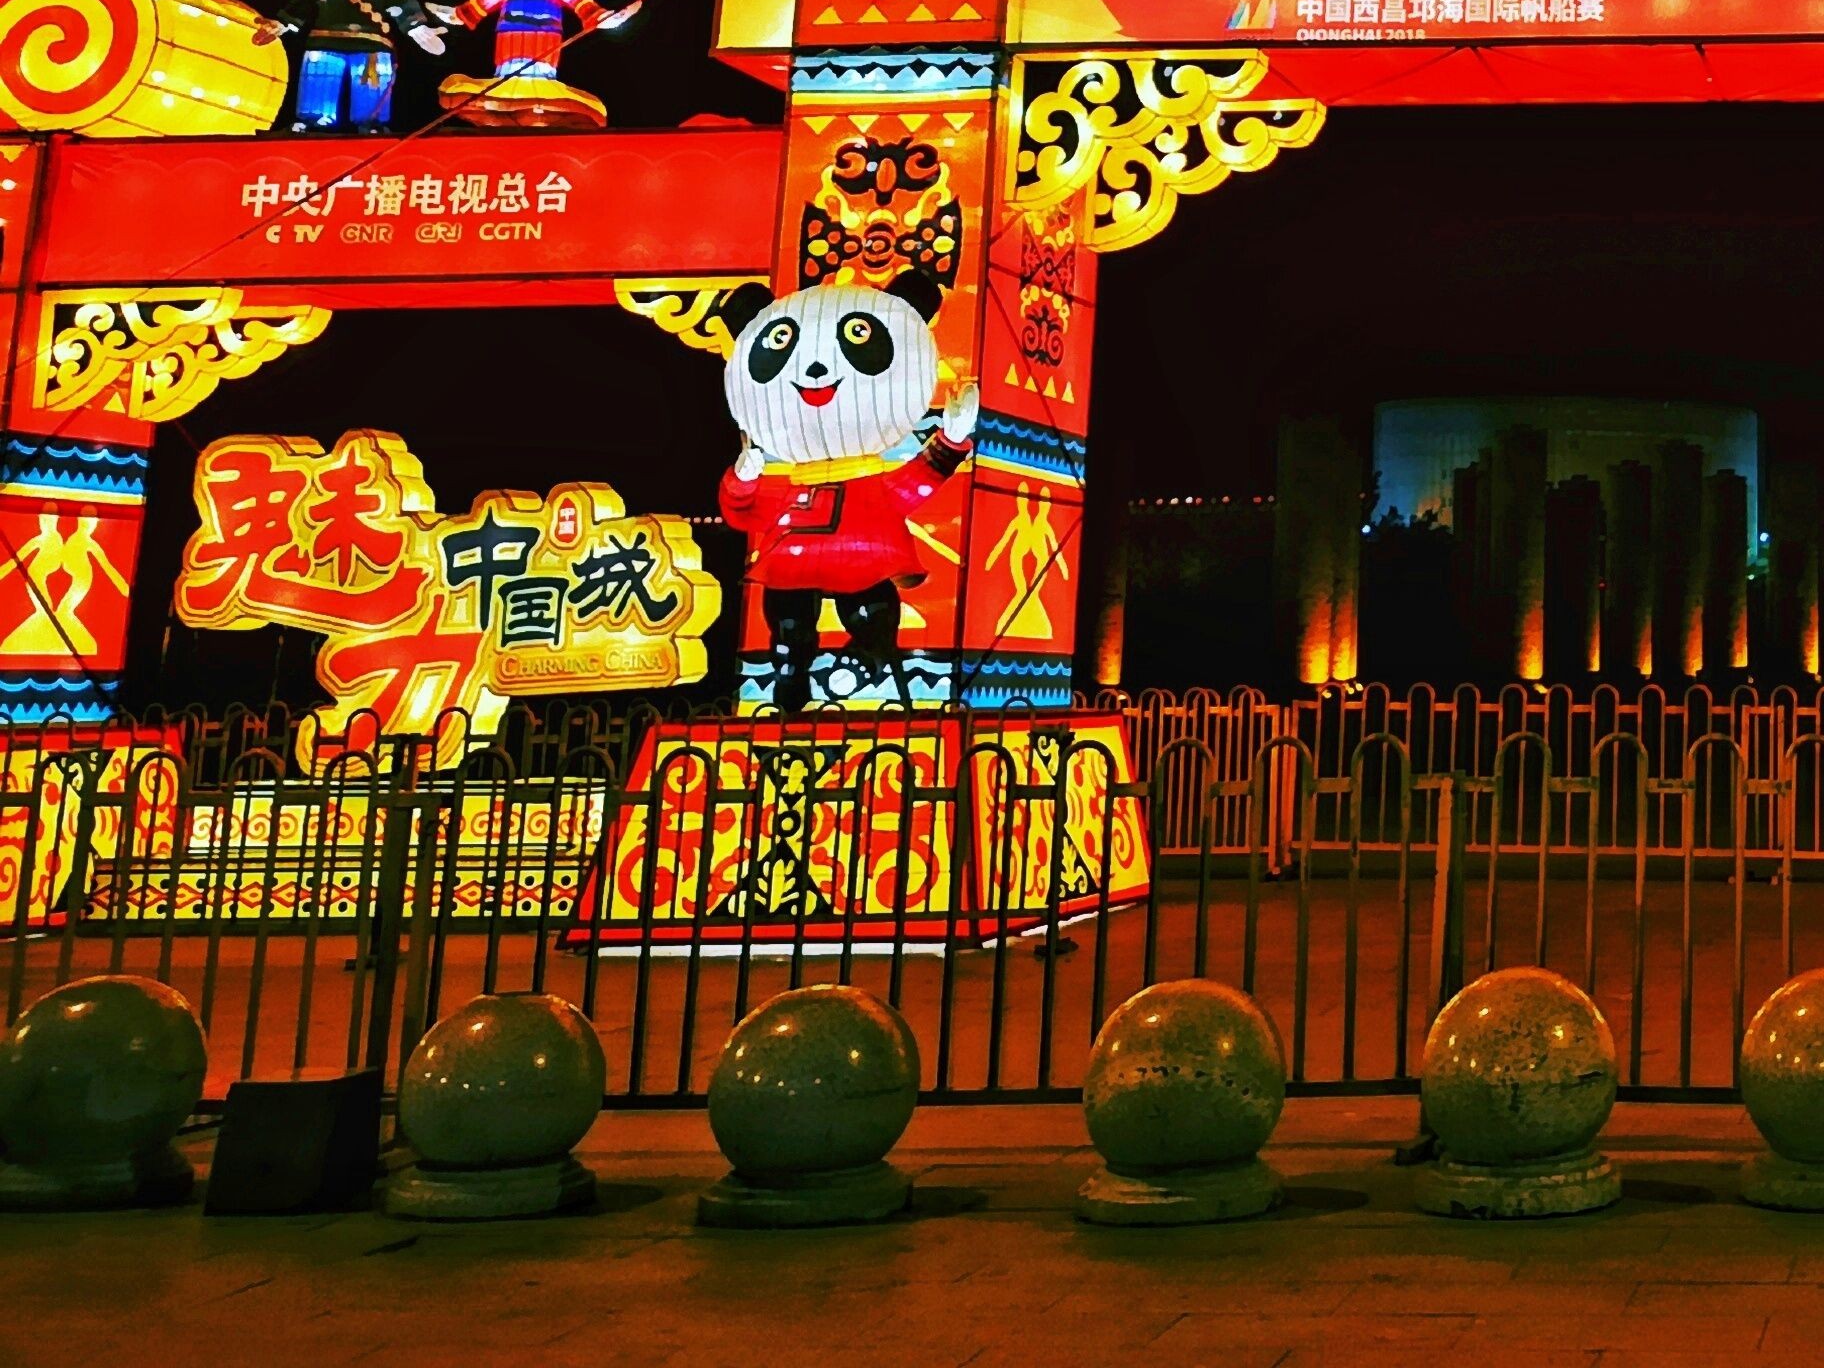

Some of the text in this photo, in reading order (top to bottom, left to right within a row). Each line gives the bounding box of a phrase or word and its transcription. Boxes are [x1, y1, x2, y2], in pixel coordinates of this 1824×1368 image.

[241, 171, 573, 217] 中央广播电视总台
[479, 221, 543, 241] CGTN
